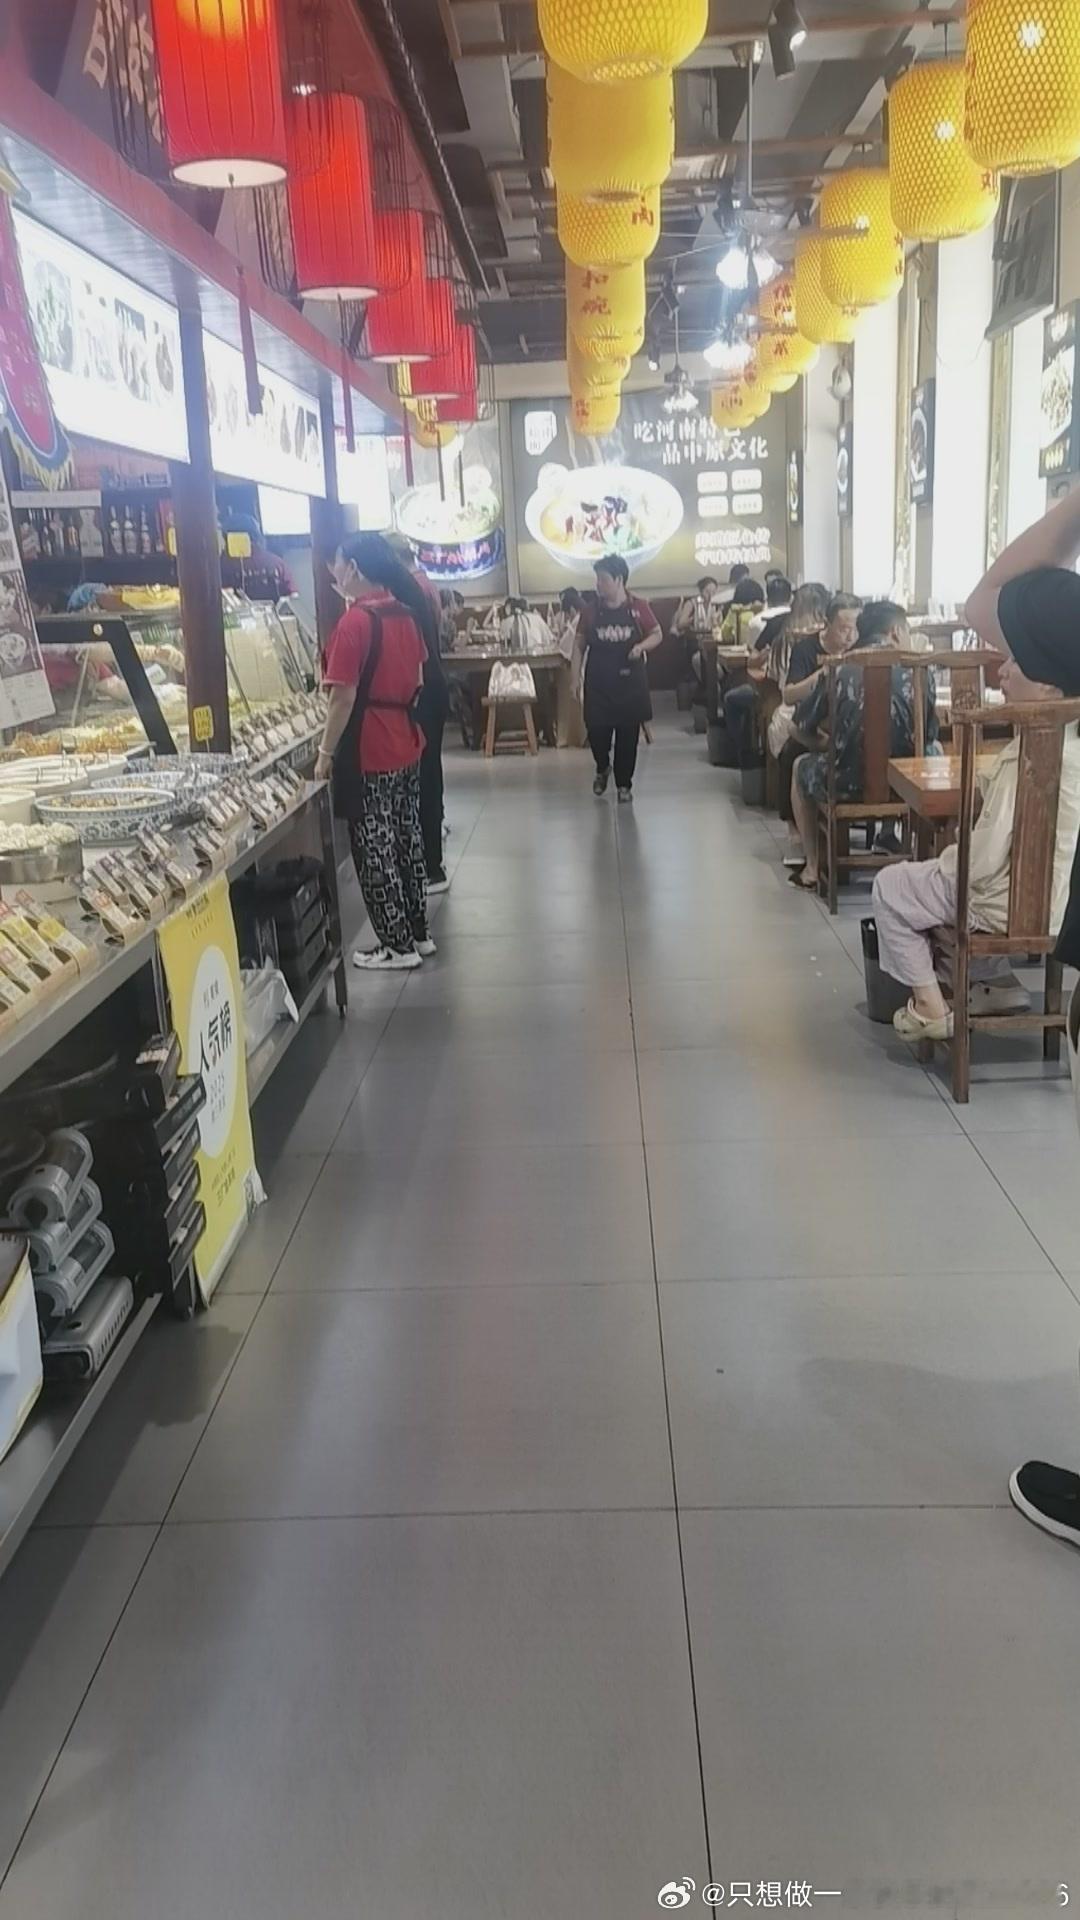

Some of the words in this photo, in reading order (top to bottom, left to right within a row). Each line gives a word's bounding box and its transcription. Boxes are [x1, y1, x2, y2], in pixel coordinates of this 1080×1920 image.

[662, 435, 769, 465] 品中原文化
[199, 1000, 233, 1073] 人气榜
